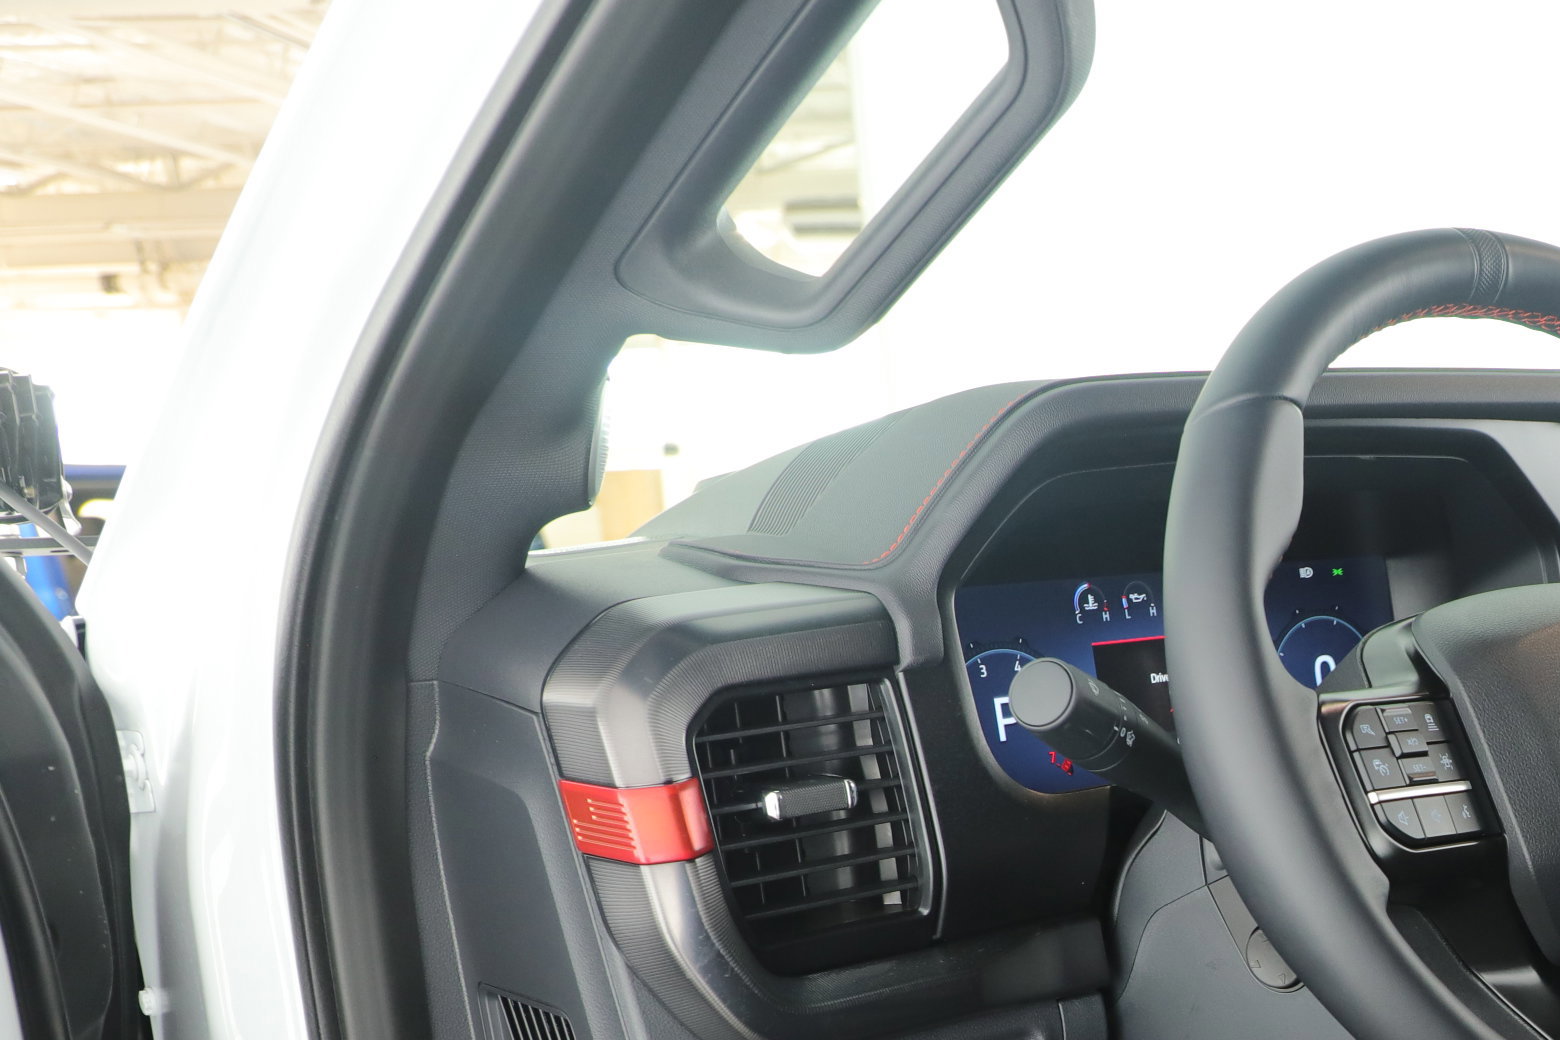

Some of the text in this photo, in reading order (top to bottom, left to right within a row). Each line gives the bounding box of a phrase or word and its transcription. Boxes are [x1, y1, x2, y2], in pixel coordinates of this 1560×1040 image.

[1076, 611, 1111, 624] C H
[1125, 606, 1157, 619] L H
[979, 664, 988, 678] 3
[1048, 751, 1056, 764] 7
